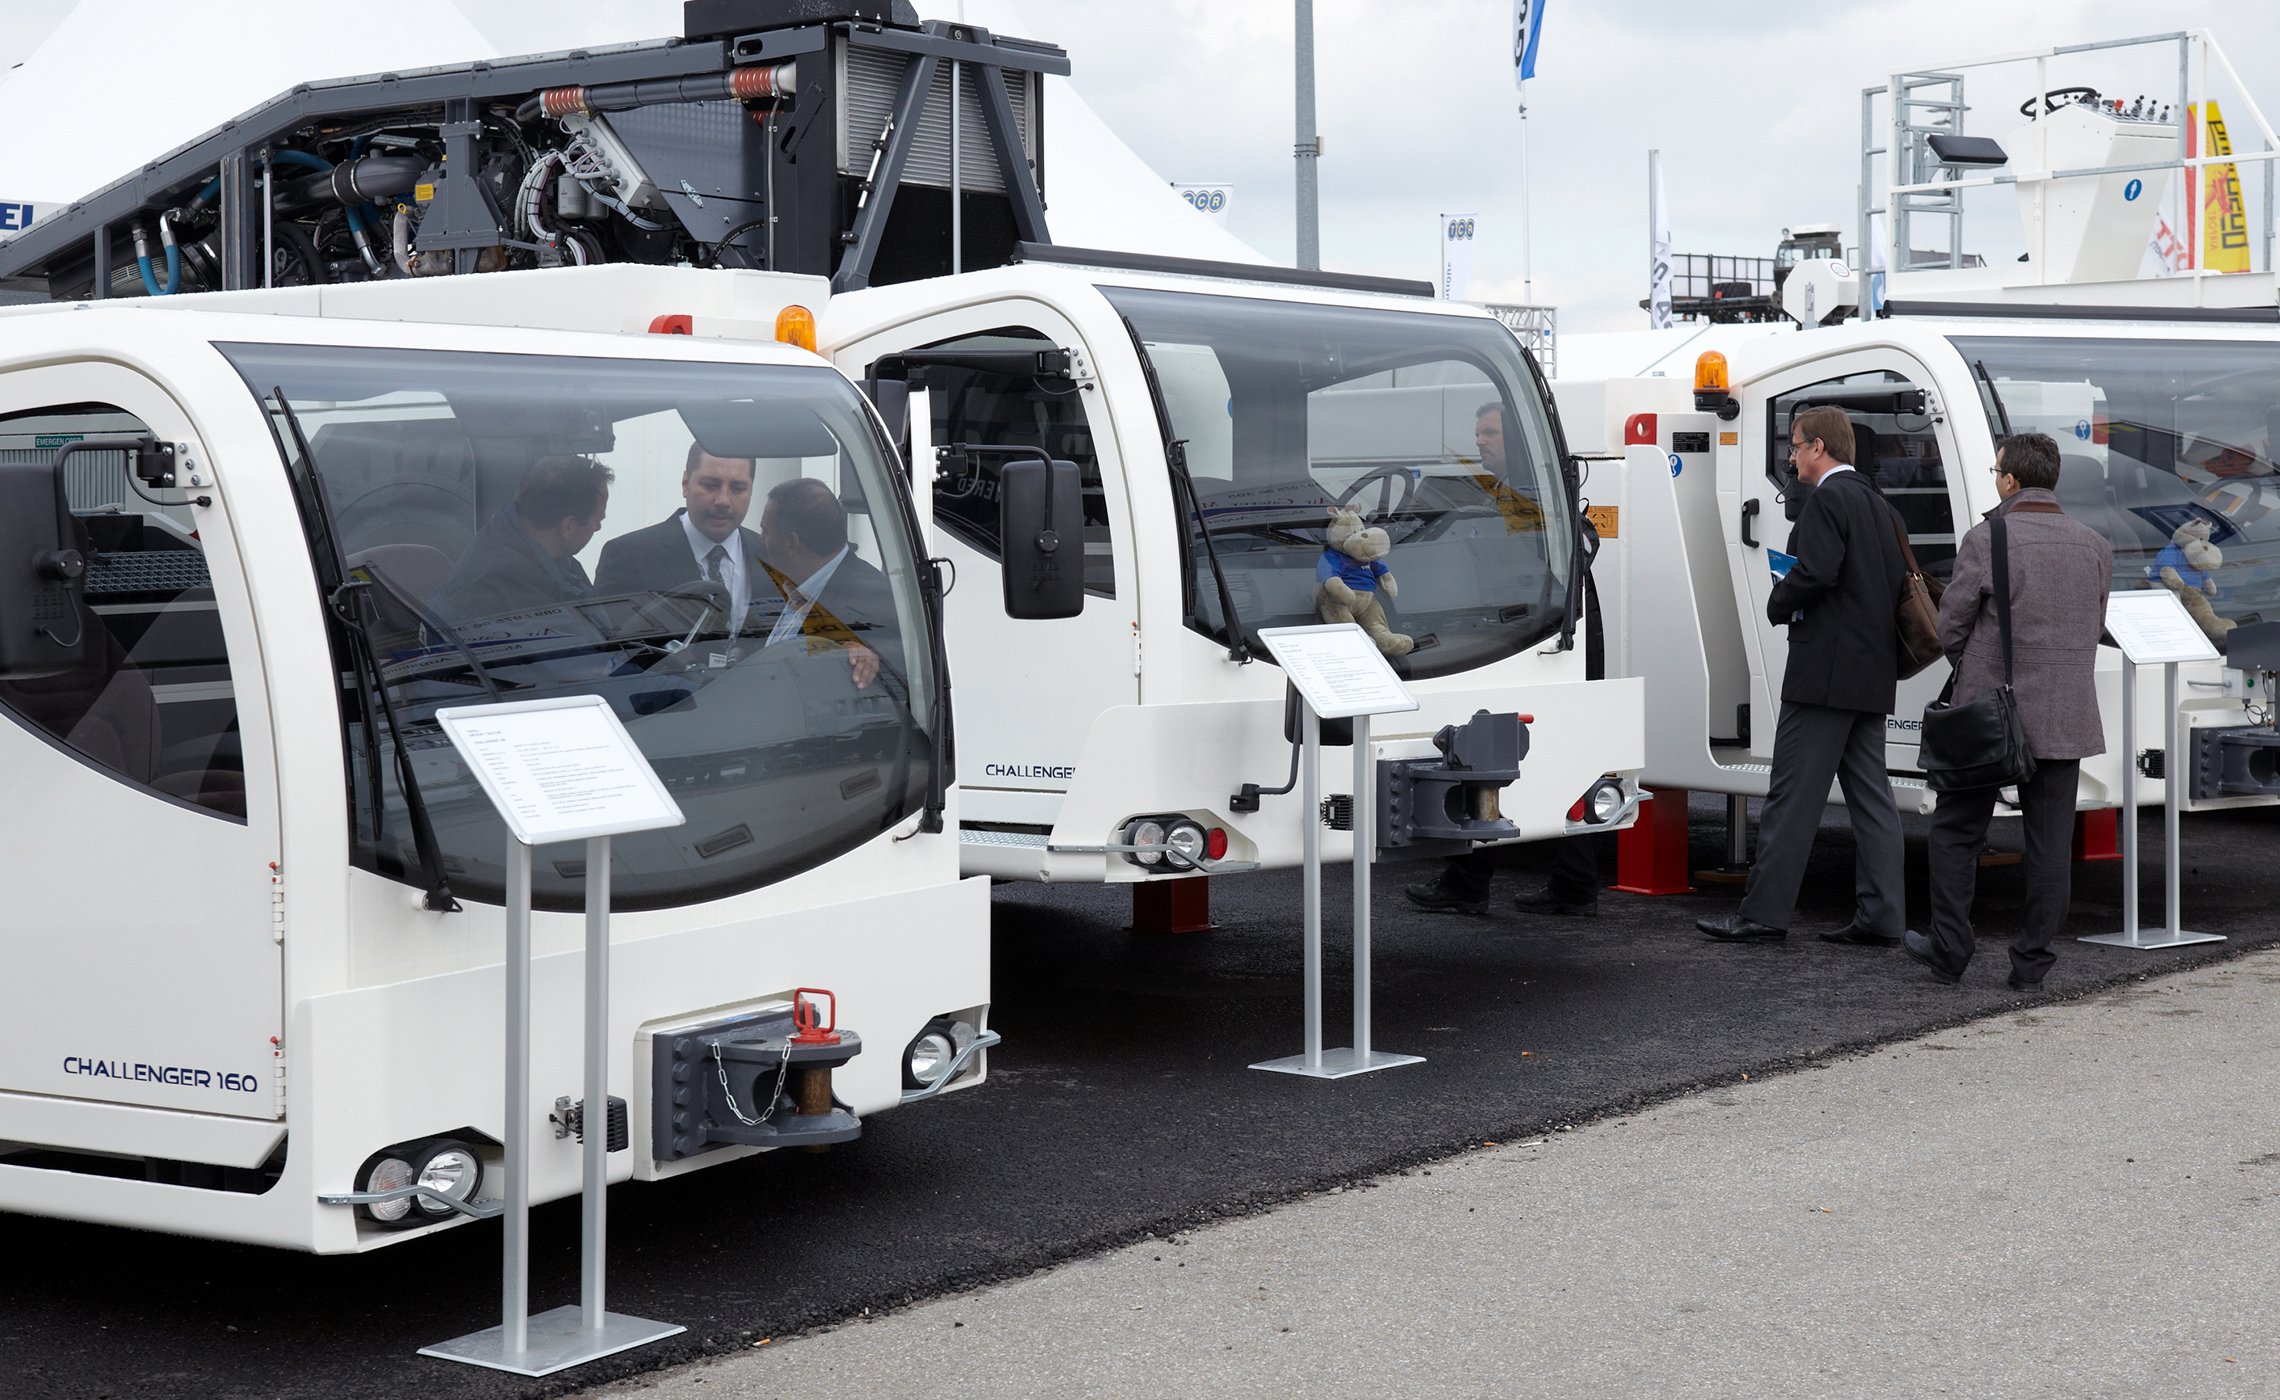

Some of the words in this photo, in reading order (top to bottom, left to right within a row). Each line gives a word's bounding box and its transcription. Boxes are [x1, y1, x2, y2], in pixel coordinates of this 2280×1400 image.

[985, 763, 1076, 779] CHALLENGE
[63, 1056, 211, 1088] CHALLENGER
[217, 1071, 258, 1092] 160
